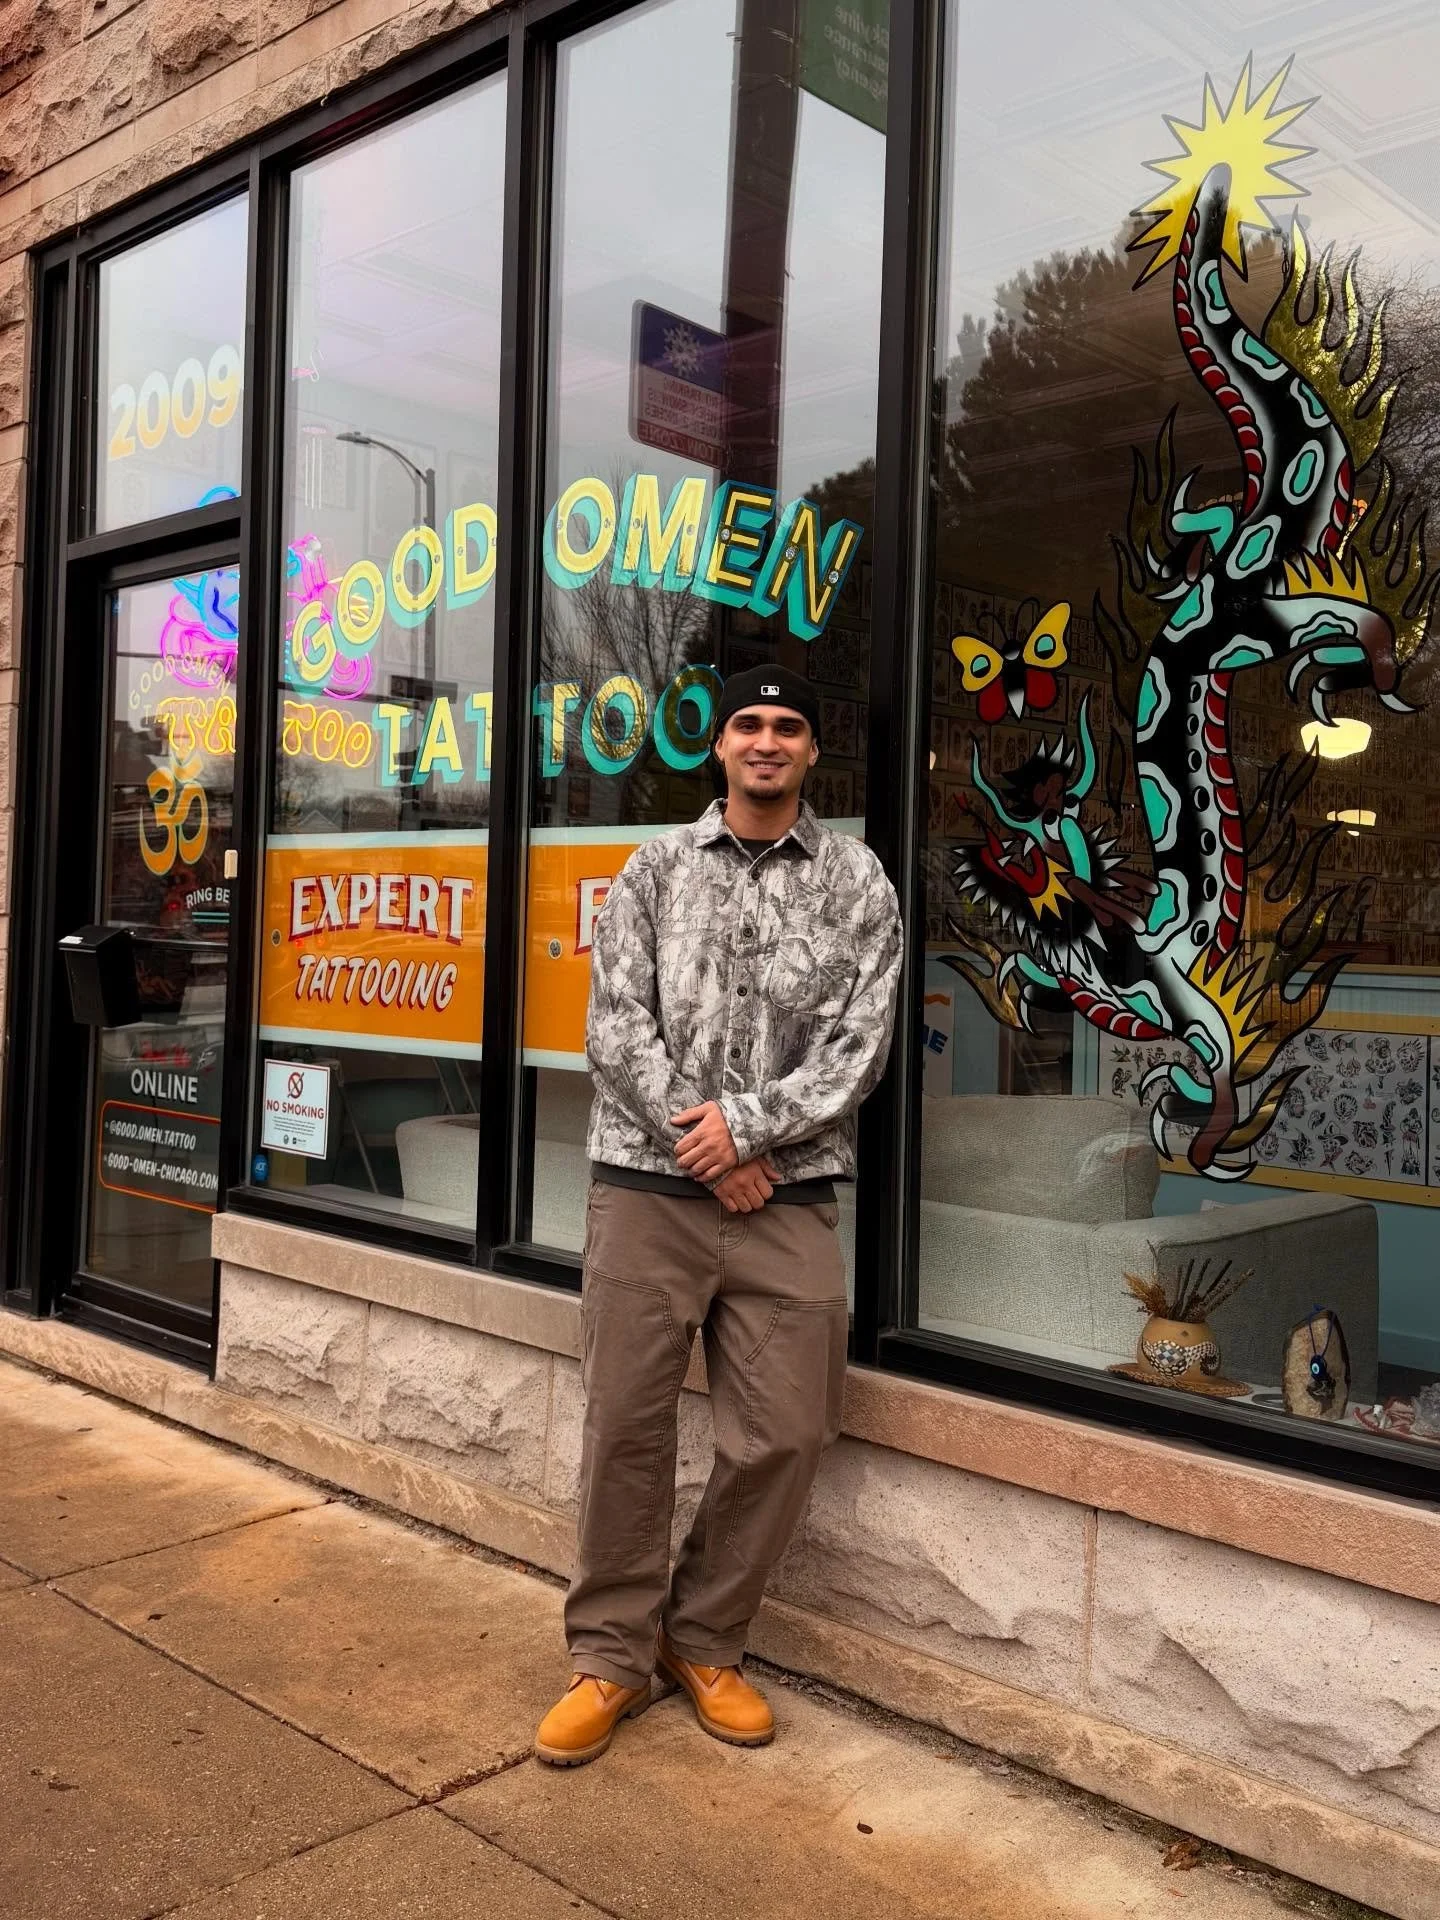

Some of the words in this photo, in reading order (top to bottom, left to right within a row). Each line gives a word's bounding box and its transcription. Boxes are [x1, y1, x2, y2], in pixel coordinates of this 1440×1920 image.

[108, 344, 243, 462] 2009
[286, 502, 498, 698] GOOD
[543, 472, 864, 641] OMEN
[129, 655, 176, 710] GOOD
[185, 887, 212, 909] RING
[215, 887, 231, 904] BE
[289, 873, 474, 946] EXPERT
[295, 954, 458, 1013] TATTOOING
[130, 1068, 199, 1104] ONLINE
[266, 1100, 280, 1112] NO
[282, 1101, 325, 1120] SMOKING
[109, 1120, 197, 1151] @GOOD.OMEN.TATTOO
[107, 1152, 219, 1191] GOOD-OMEN-CHICAGO.COM
